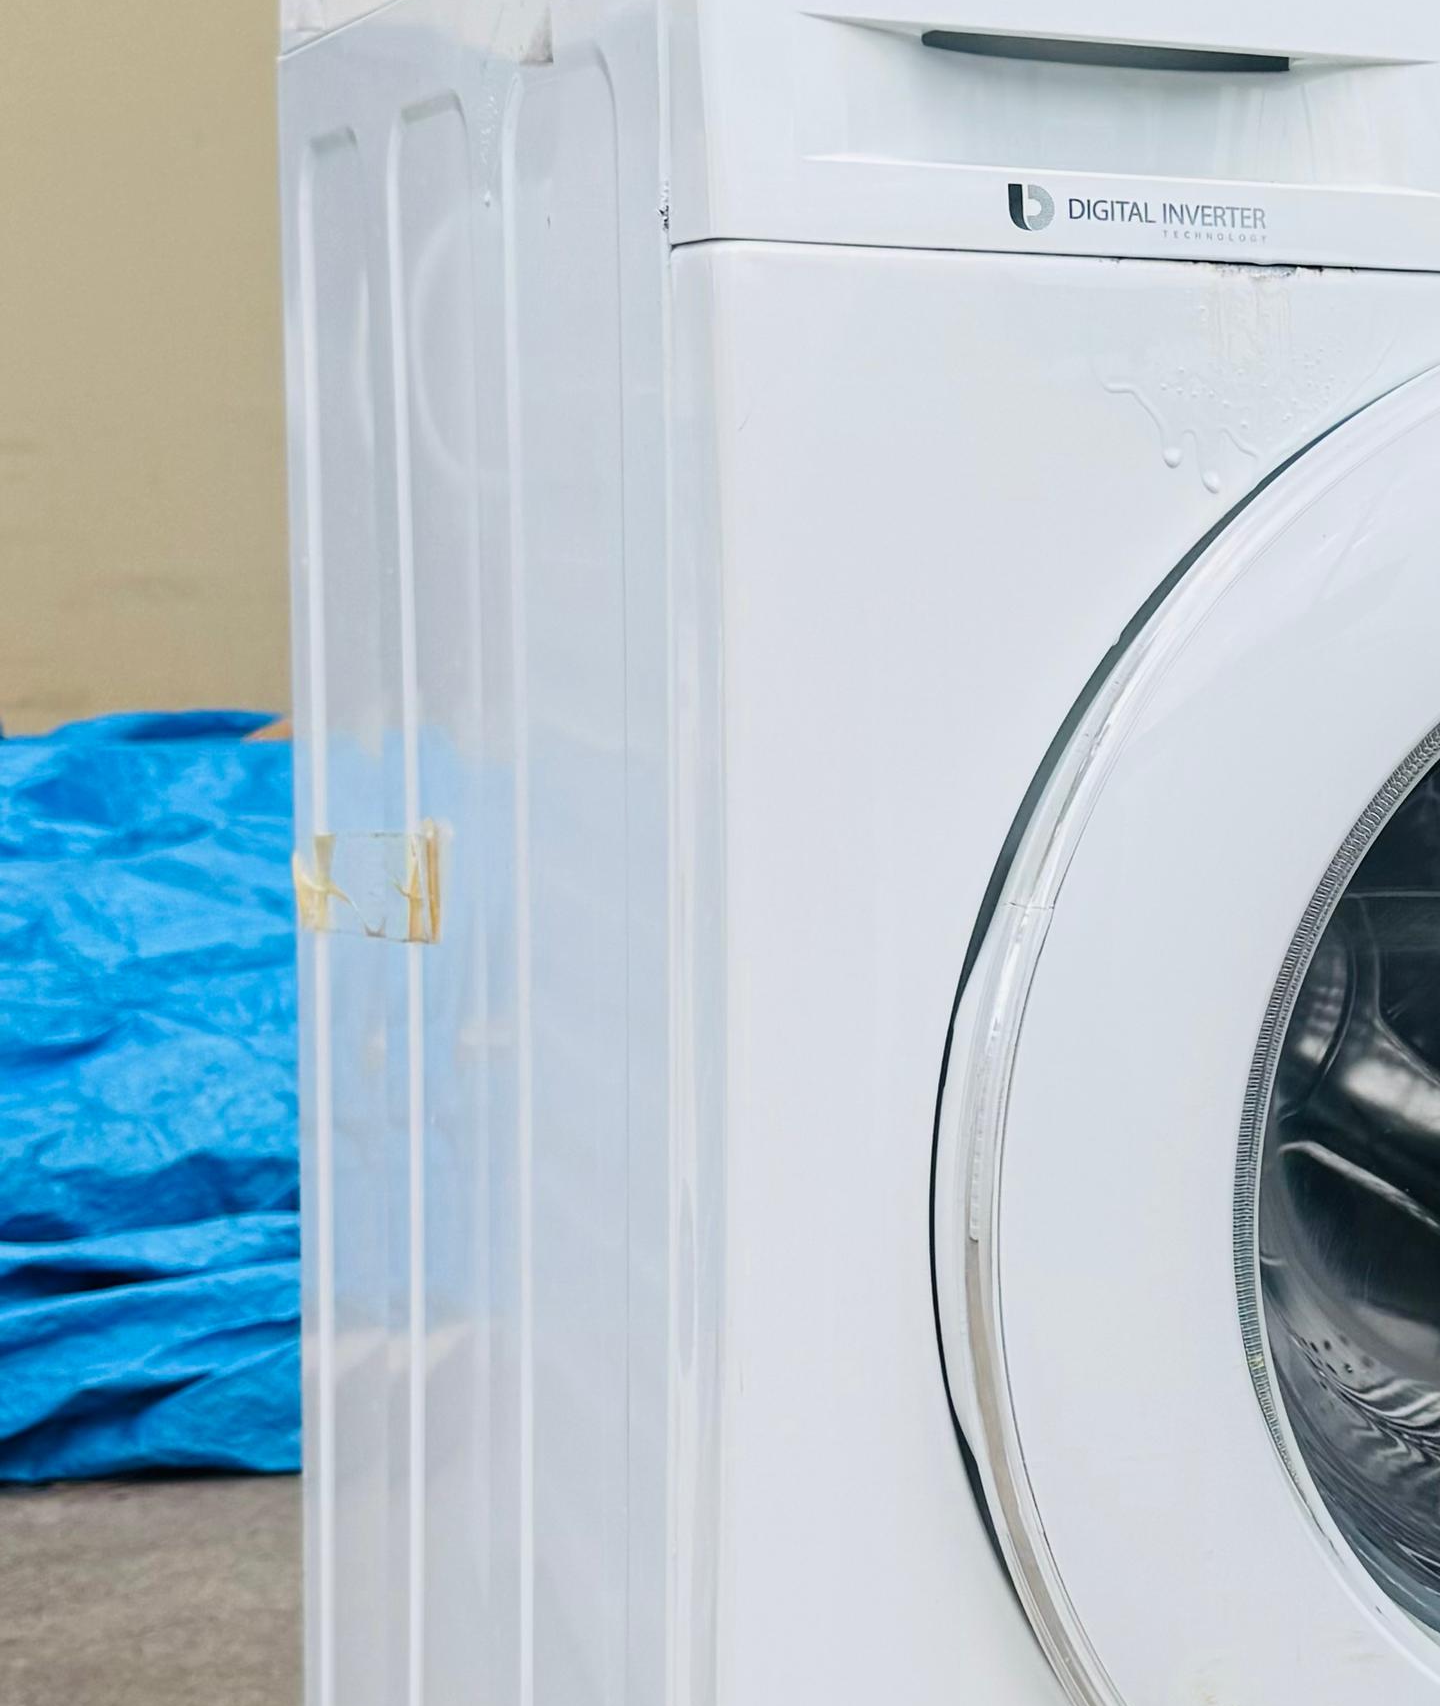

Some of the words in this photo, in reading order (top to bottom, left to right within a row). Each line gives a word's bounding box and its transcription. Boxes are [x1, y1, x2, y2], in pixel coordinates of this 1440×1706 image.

[1068, 198, 1156, 224] DIGITAL
[1162, 202, 1266, 230] INVERTER
[1162, 230, 1267, 243] TECHNOLOGY
